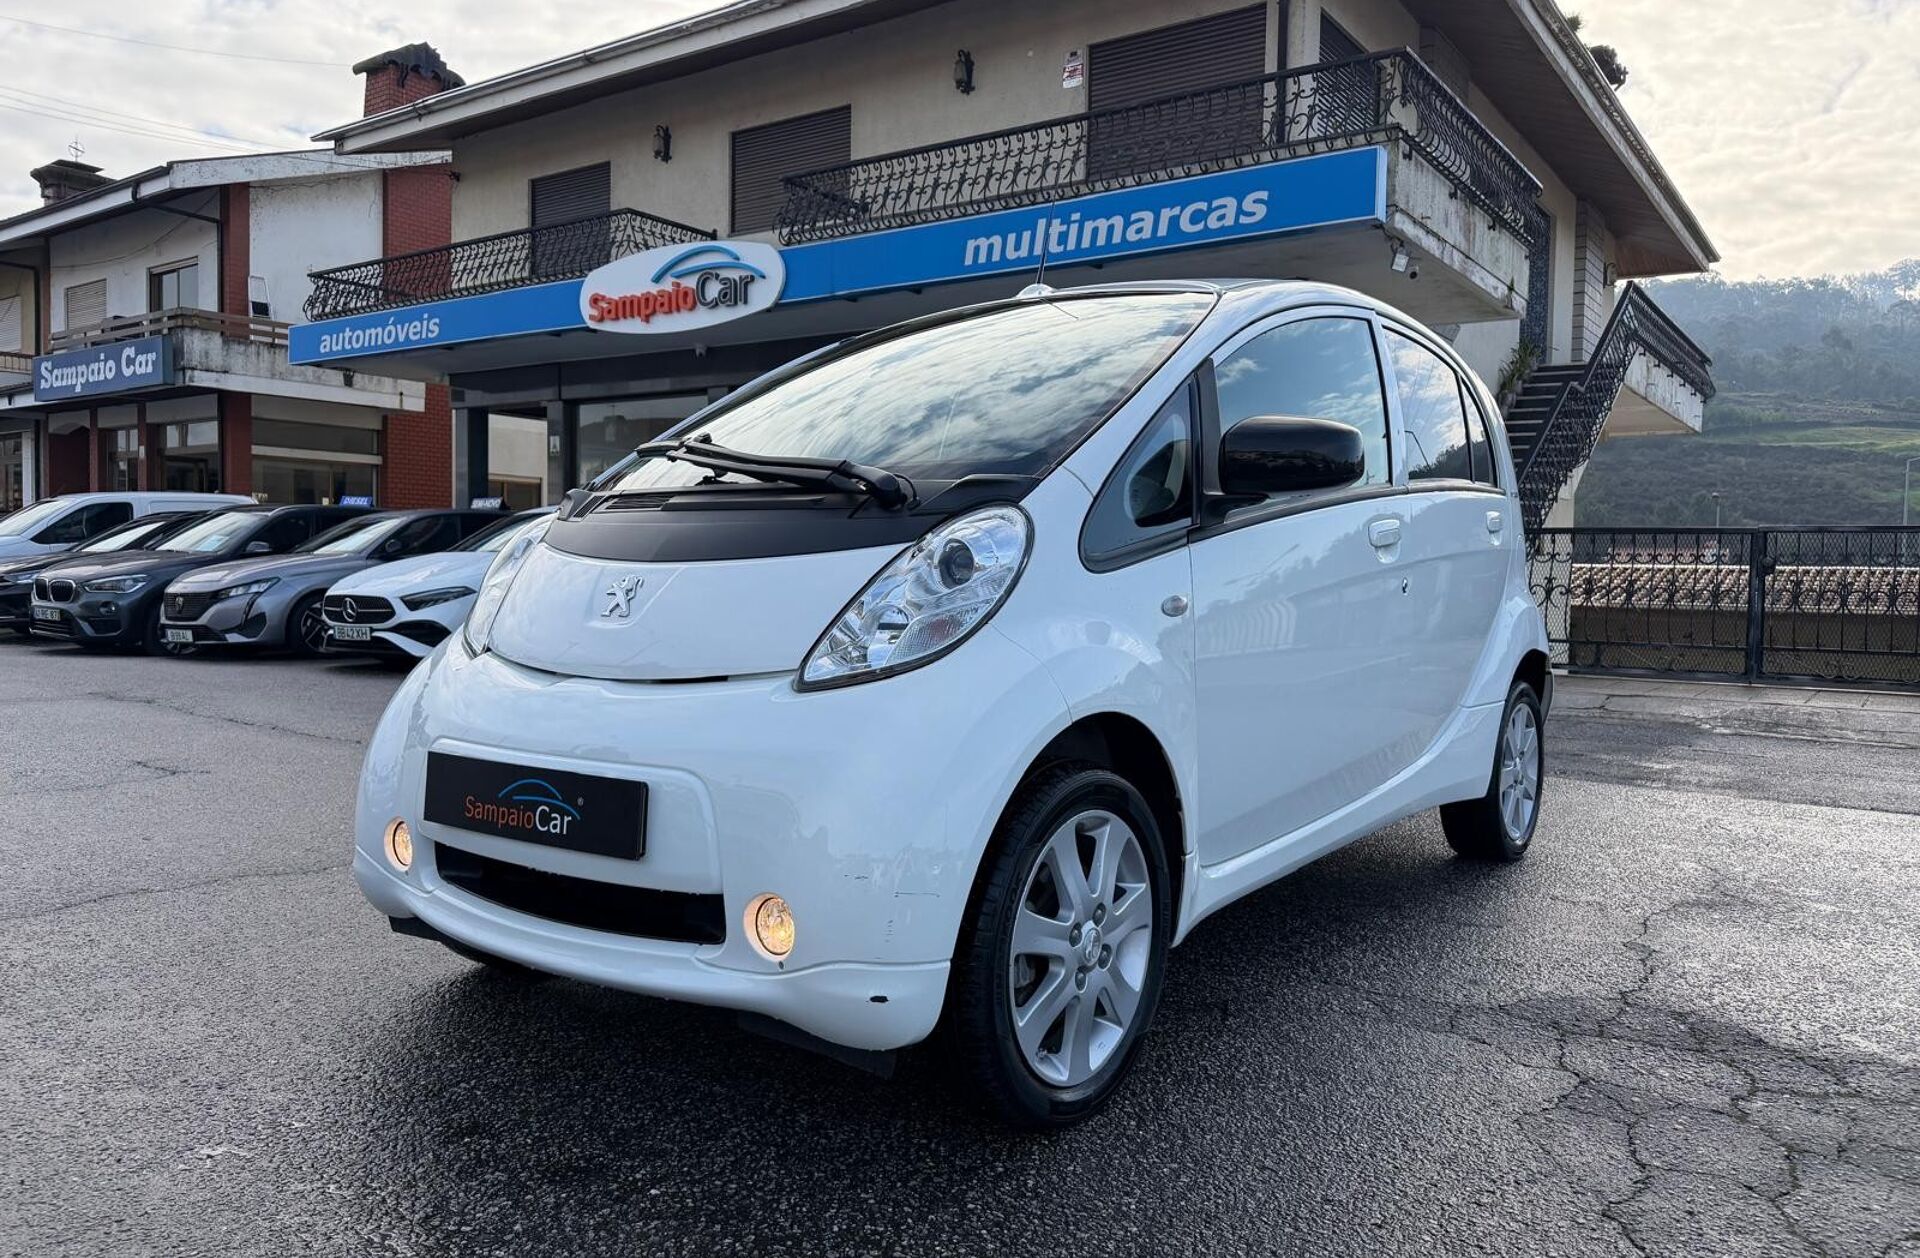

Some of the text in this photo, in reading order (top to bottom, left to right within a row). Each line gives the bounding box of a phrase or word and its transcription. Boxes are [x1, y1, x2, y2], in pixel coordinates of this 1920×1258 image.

[963, 189, 1269, 266] multimarcas
[319, 315, 440, 354] automóveis
[40, 346, 157, 392] Sampaio Car
[465, 795, 572, 835] SampaioCar
